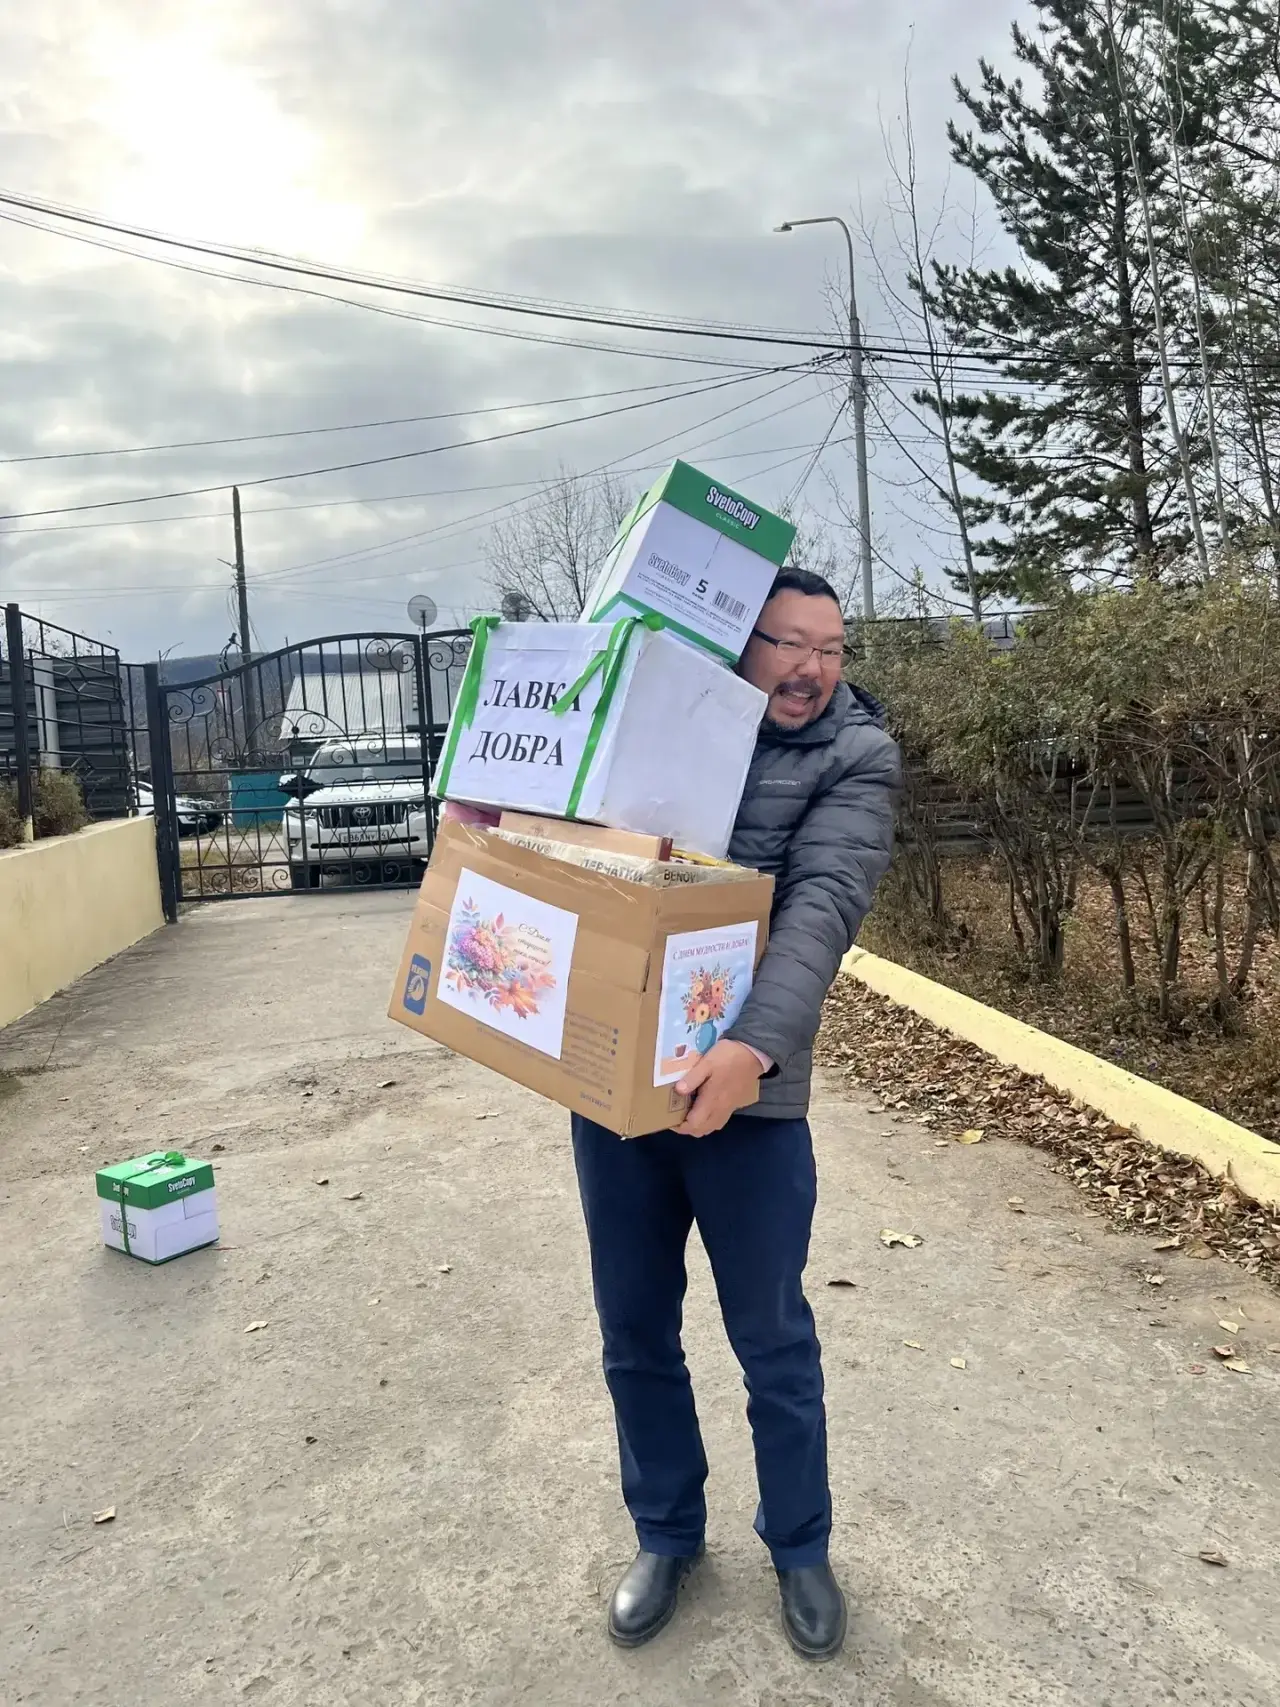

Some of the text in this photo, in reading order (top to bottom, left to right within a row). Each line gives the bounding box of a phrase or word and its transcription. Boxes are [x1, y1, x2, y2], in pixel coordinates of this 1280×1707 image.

[705, 485, 761, 530] SvetoCopy
[648, 552, 691, 587] SvetoCopy
[695, 578, 709, 594] 5
[468, 730, 564, 766] ДОБРА
[167, 1176, 196, 1192] SvetoCopy
